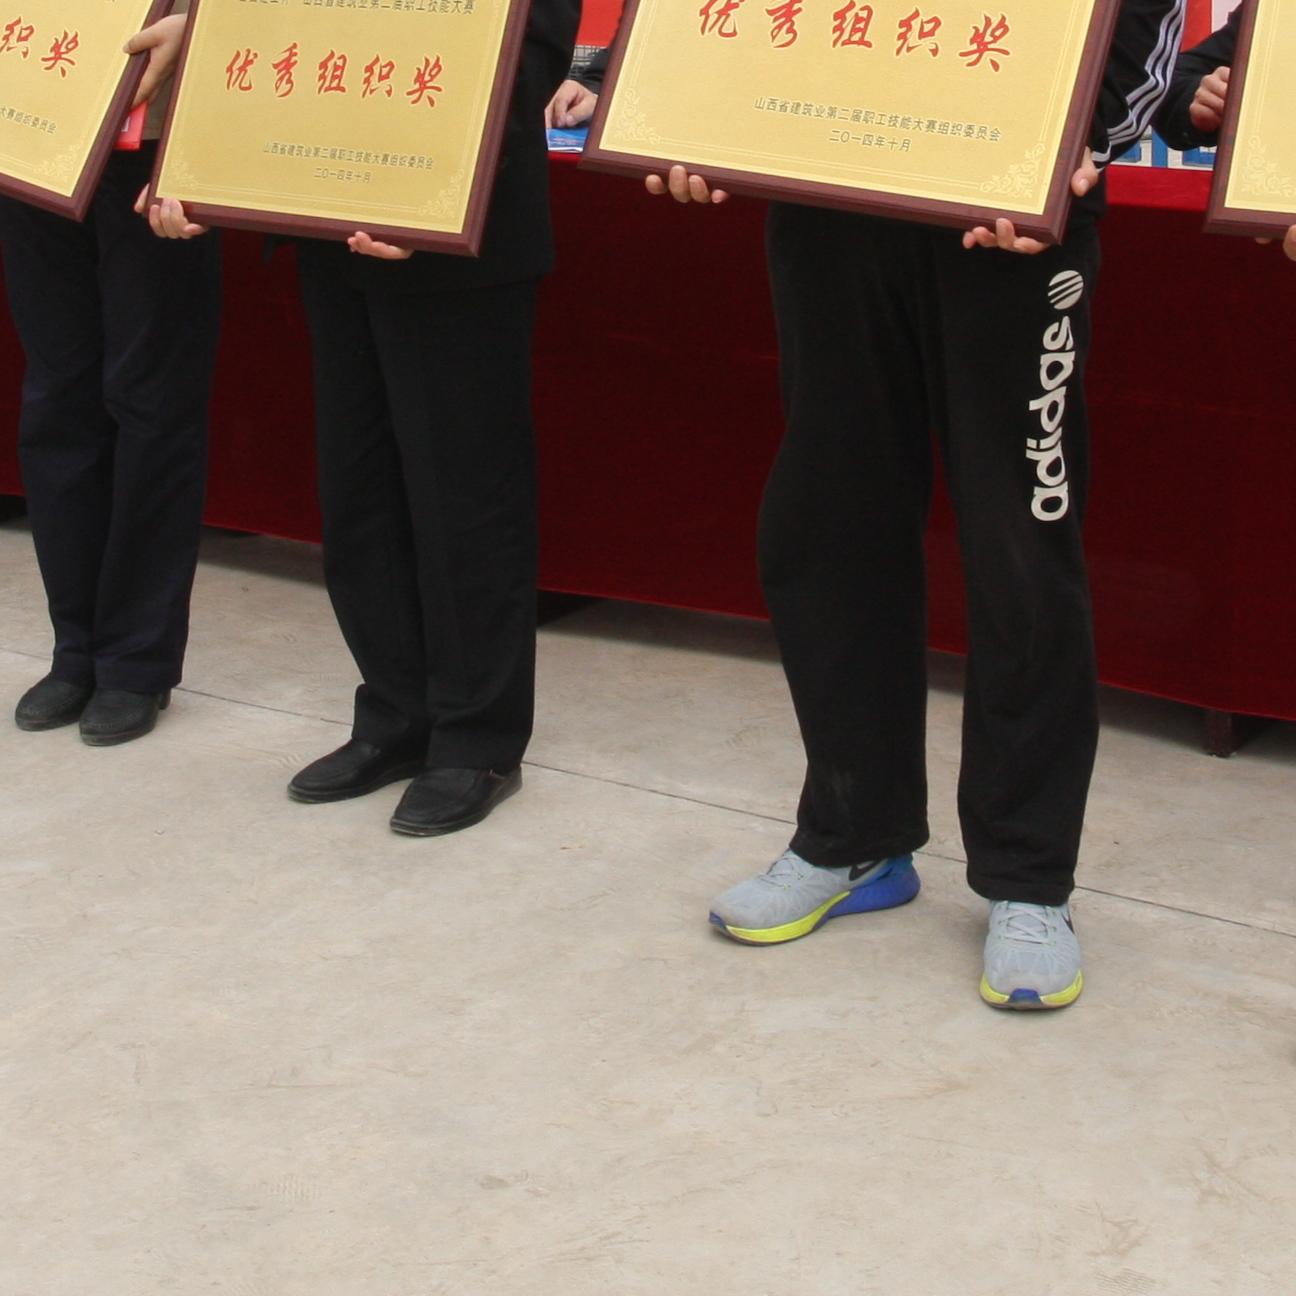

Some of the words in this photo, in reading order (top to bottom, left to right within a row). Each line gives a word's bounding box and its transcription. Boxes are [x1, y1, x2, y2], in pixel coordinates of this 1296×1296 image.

[225, 42, 443, 107] 优秀组织奖
[1025, 315, 1075, 521] adidas
